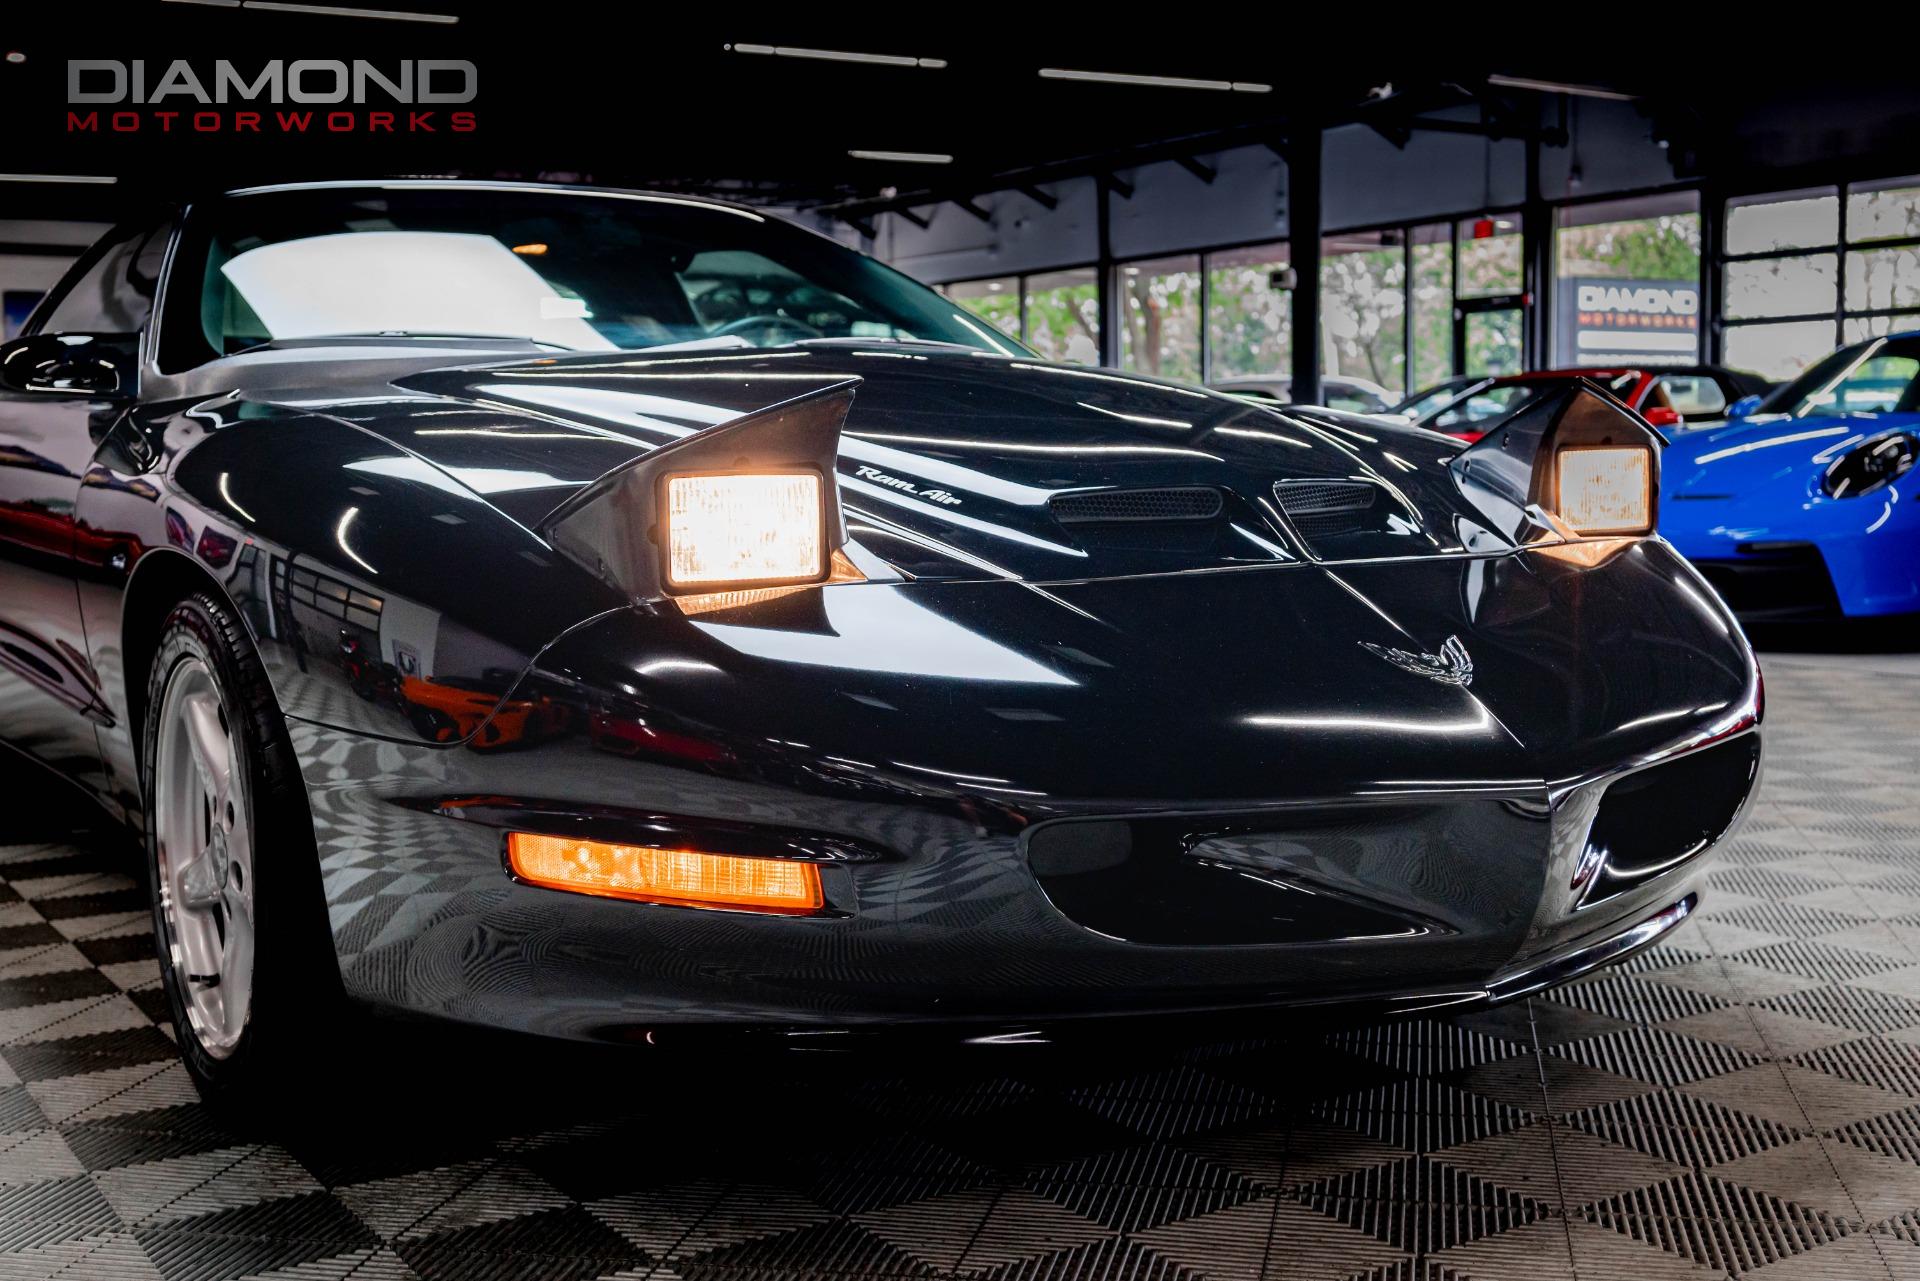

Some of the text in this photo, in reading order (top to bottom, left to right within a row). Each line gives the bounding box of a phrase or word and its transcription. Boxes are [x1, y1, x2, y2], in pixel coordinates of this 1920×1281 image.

[1577, 286, 1698, 314] DIAMOND
[855, 465, 962, 505] Ram Air
